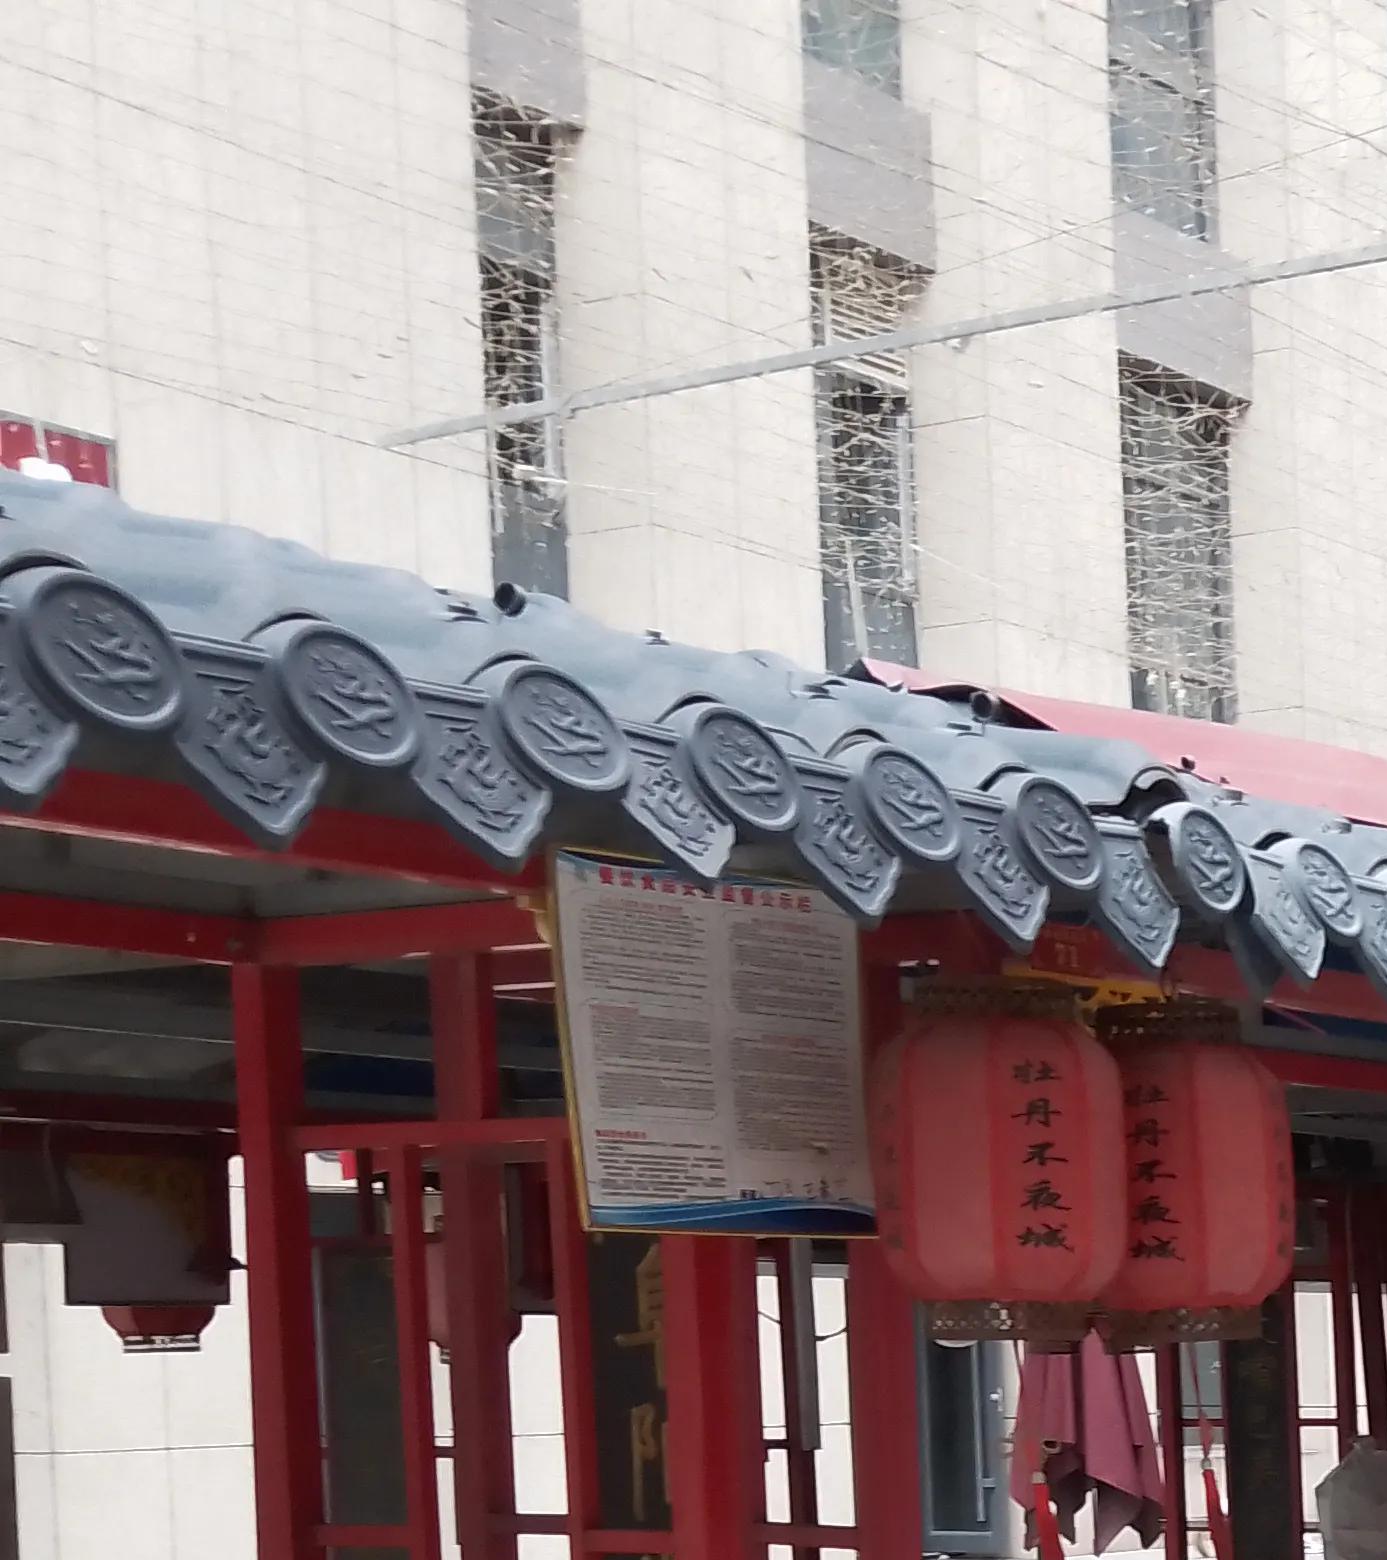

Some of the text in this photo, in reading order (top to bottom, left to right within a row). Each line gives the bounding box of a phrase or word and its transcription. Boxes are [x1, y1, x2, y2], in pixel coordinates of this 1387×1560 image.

[1010, 1058, 1077, 1255] 牡丹不夜城
[1124, 1083, 1186, 1263] 牡丹不夜城
